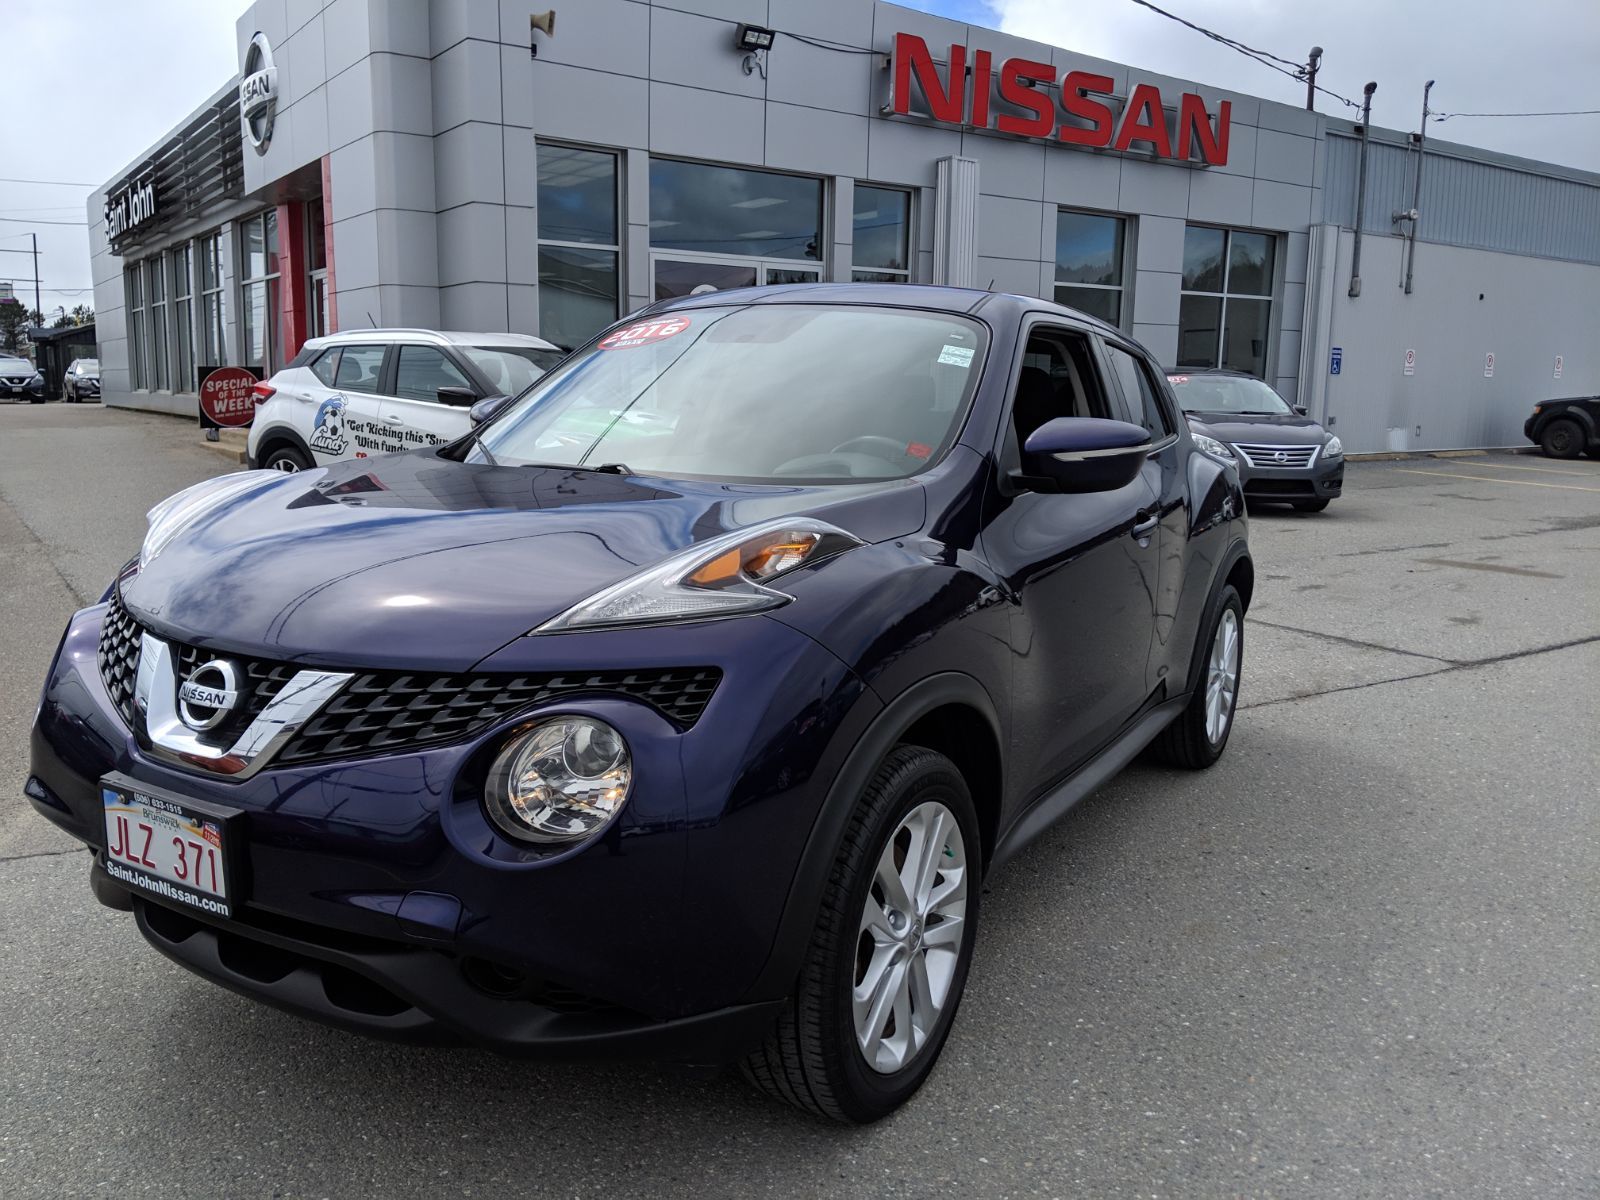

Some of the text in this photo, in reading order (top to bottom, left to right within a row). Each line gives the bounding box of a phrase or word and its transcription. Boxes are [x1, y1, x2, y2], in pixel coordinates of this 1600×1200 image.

[891, 31, 1232, 167] NISSAN
[104, 180, 155, 242] Saint John
[601, 322, 686, 345] 2016
[206, 377, 255, 392] SPECIAL
[218, 388, 246, 399] OF THE
[213, 396, 254, 413] WEEK
[347, 419, 365, 433] Get
[366, 422, 403, 442] Kicking
[405, 430, 424, 444] this
[355, 434, 380, 450] With
[181, 685, 226, 705] NISSAN
[151, 798, 182, 815] 633-1515
[110, 815, 217, 893] JLZ 371
[106, 861, 229, 916] SaintJohnNissan.com
